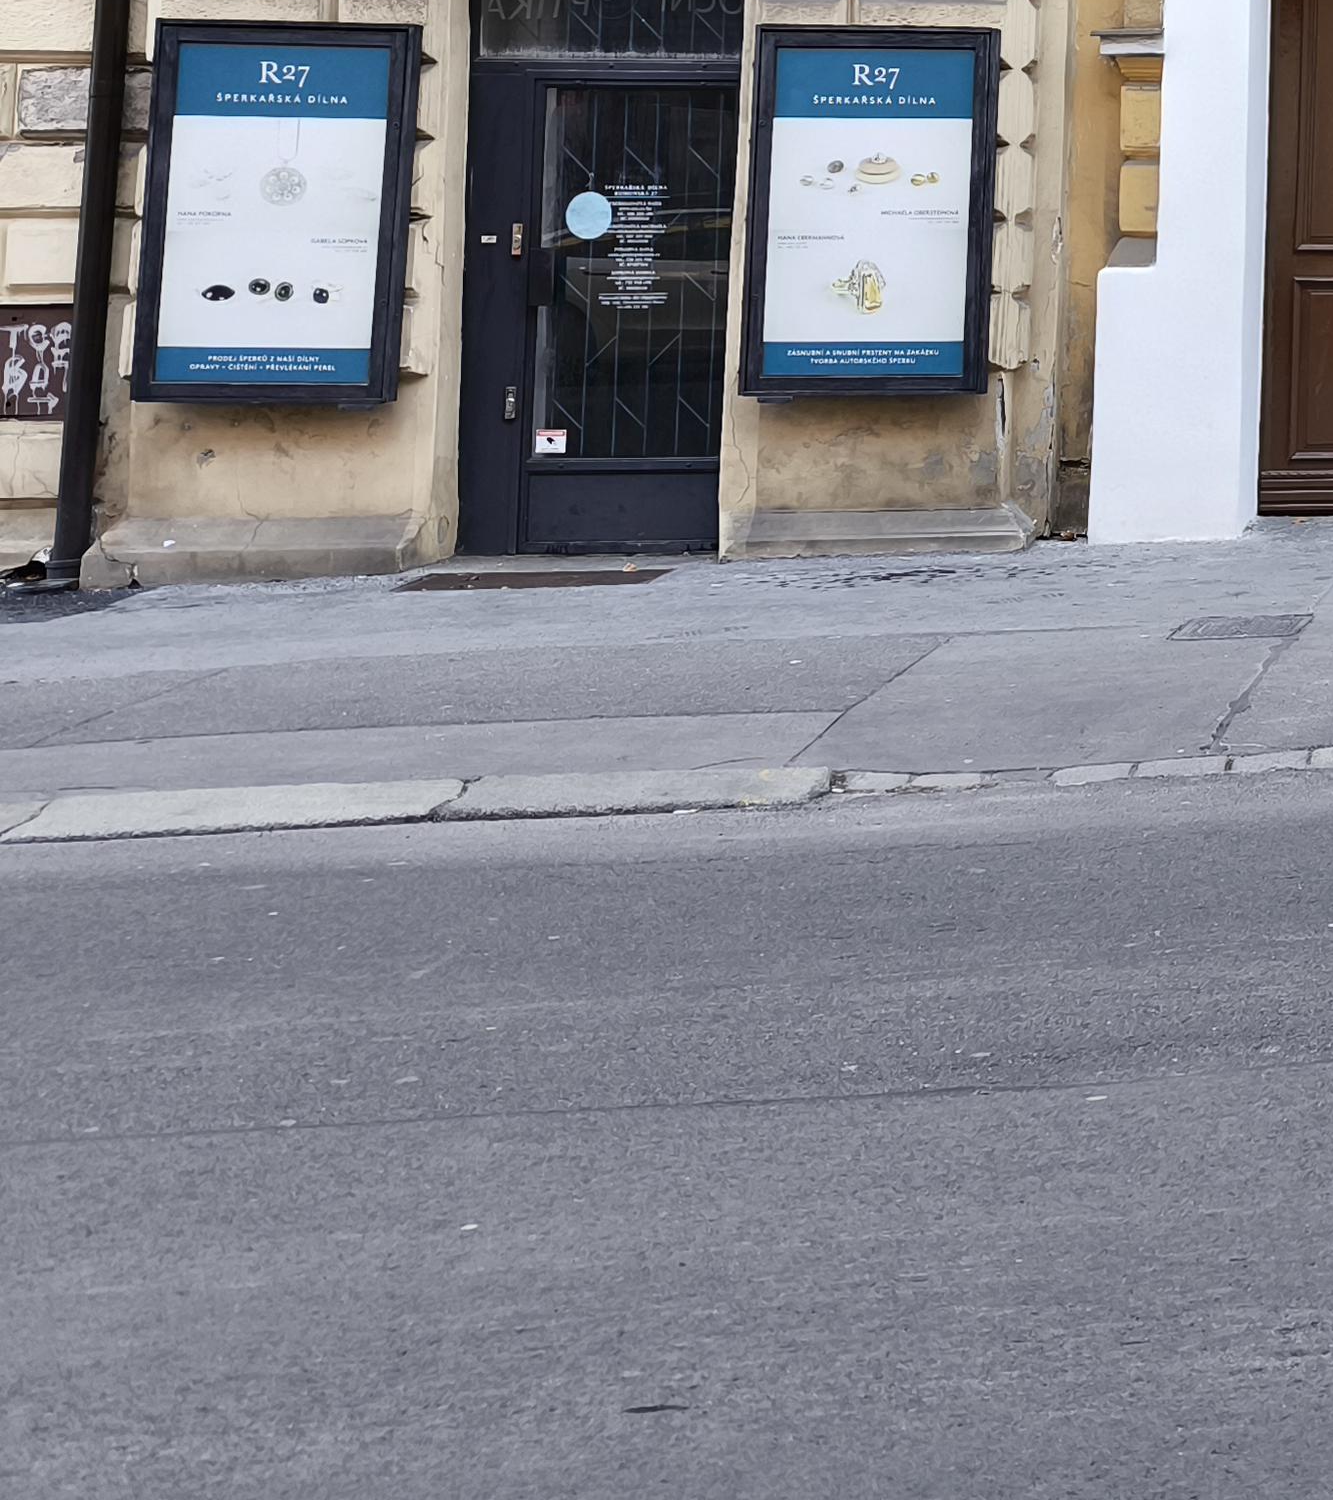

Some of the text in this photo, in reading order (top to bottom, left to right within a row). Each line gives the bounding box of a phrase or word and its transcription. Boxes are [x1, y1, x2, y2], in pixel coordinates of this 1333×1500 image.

[258, 61, 311, 88] R27
[852, 63, 900, 90] R27
[216, 92, 348, 105] ŠPERKAŘSKÁ DÍLNA
[812, 94, 937, 105] ŠPERKAŘSKÁ DÍLNA
